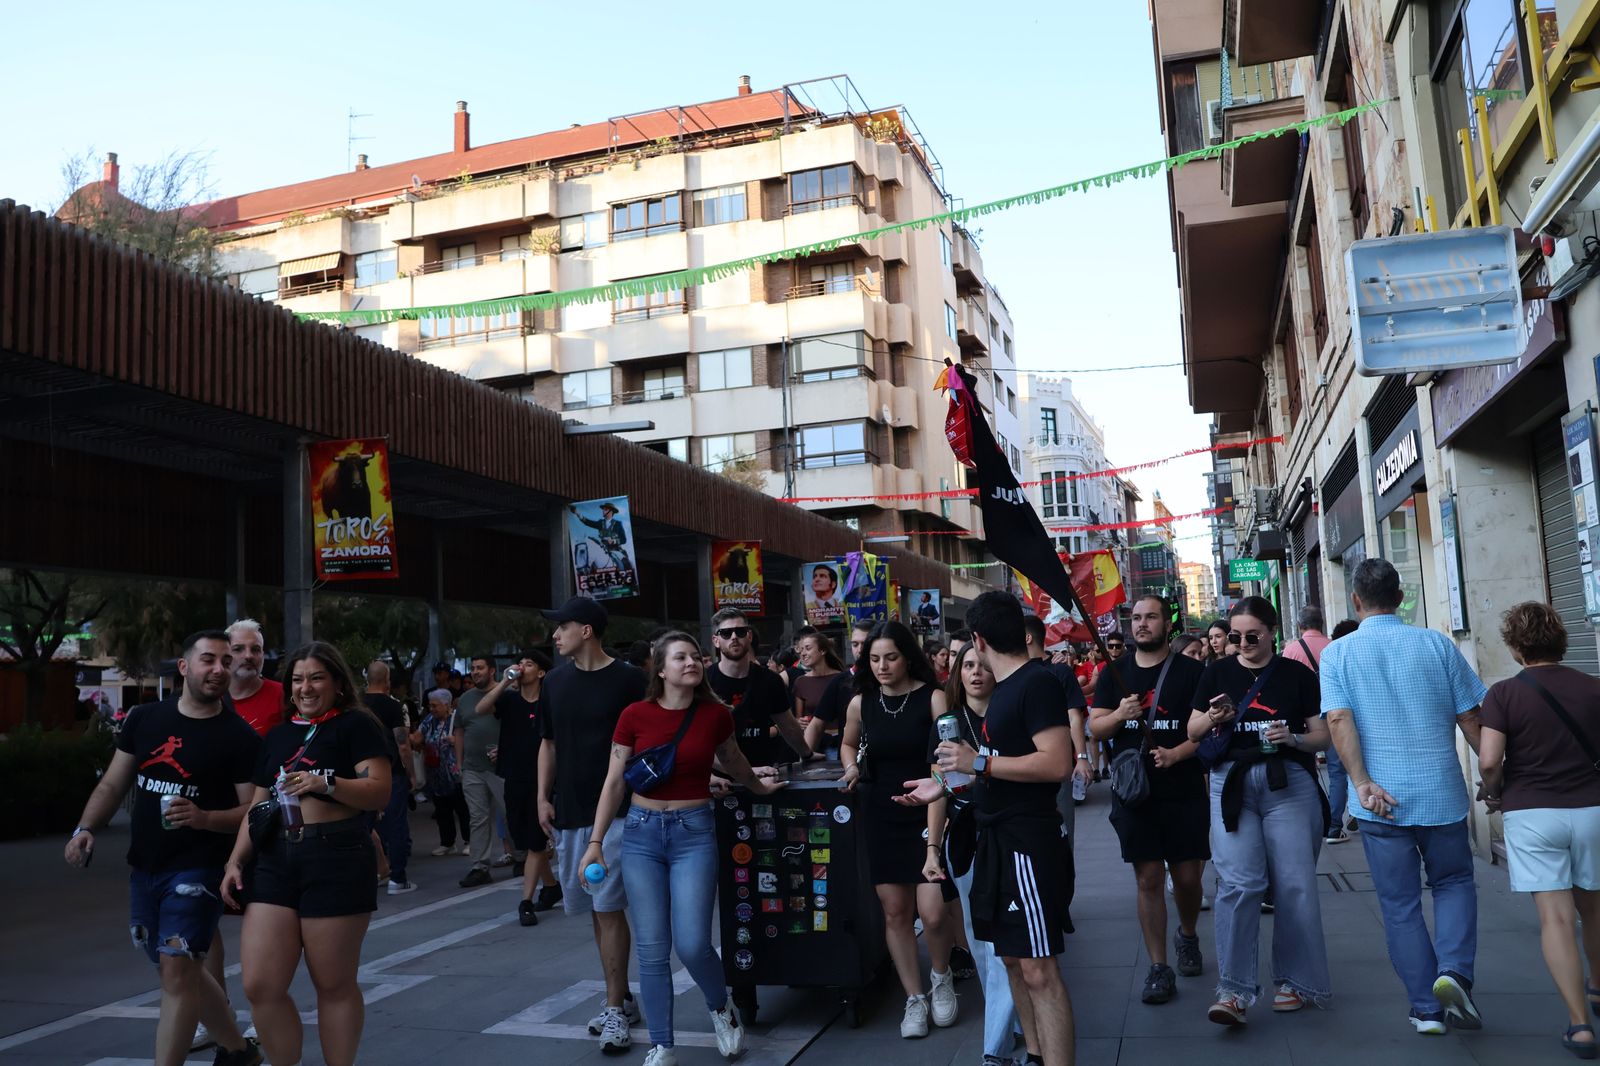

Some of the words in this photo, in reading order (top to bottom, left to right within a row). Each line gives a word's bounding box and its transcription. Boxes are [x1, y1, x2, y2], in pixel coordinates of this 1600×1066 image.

[1376, 430, 1417, 496] CALZEDONIA
[317, 512, 388, 544] TOROS
[321, 545, 391, 557] ZAMORA
[715, 580, 759, 596] TOROS
[718, 597, 762, 605] ZAMORA
[145, 778, 184, 795] DRINK
